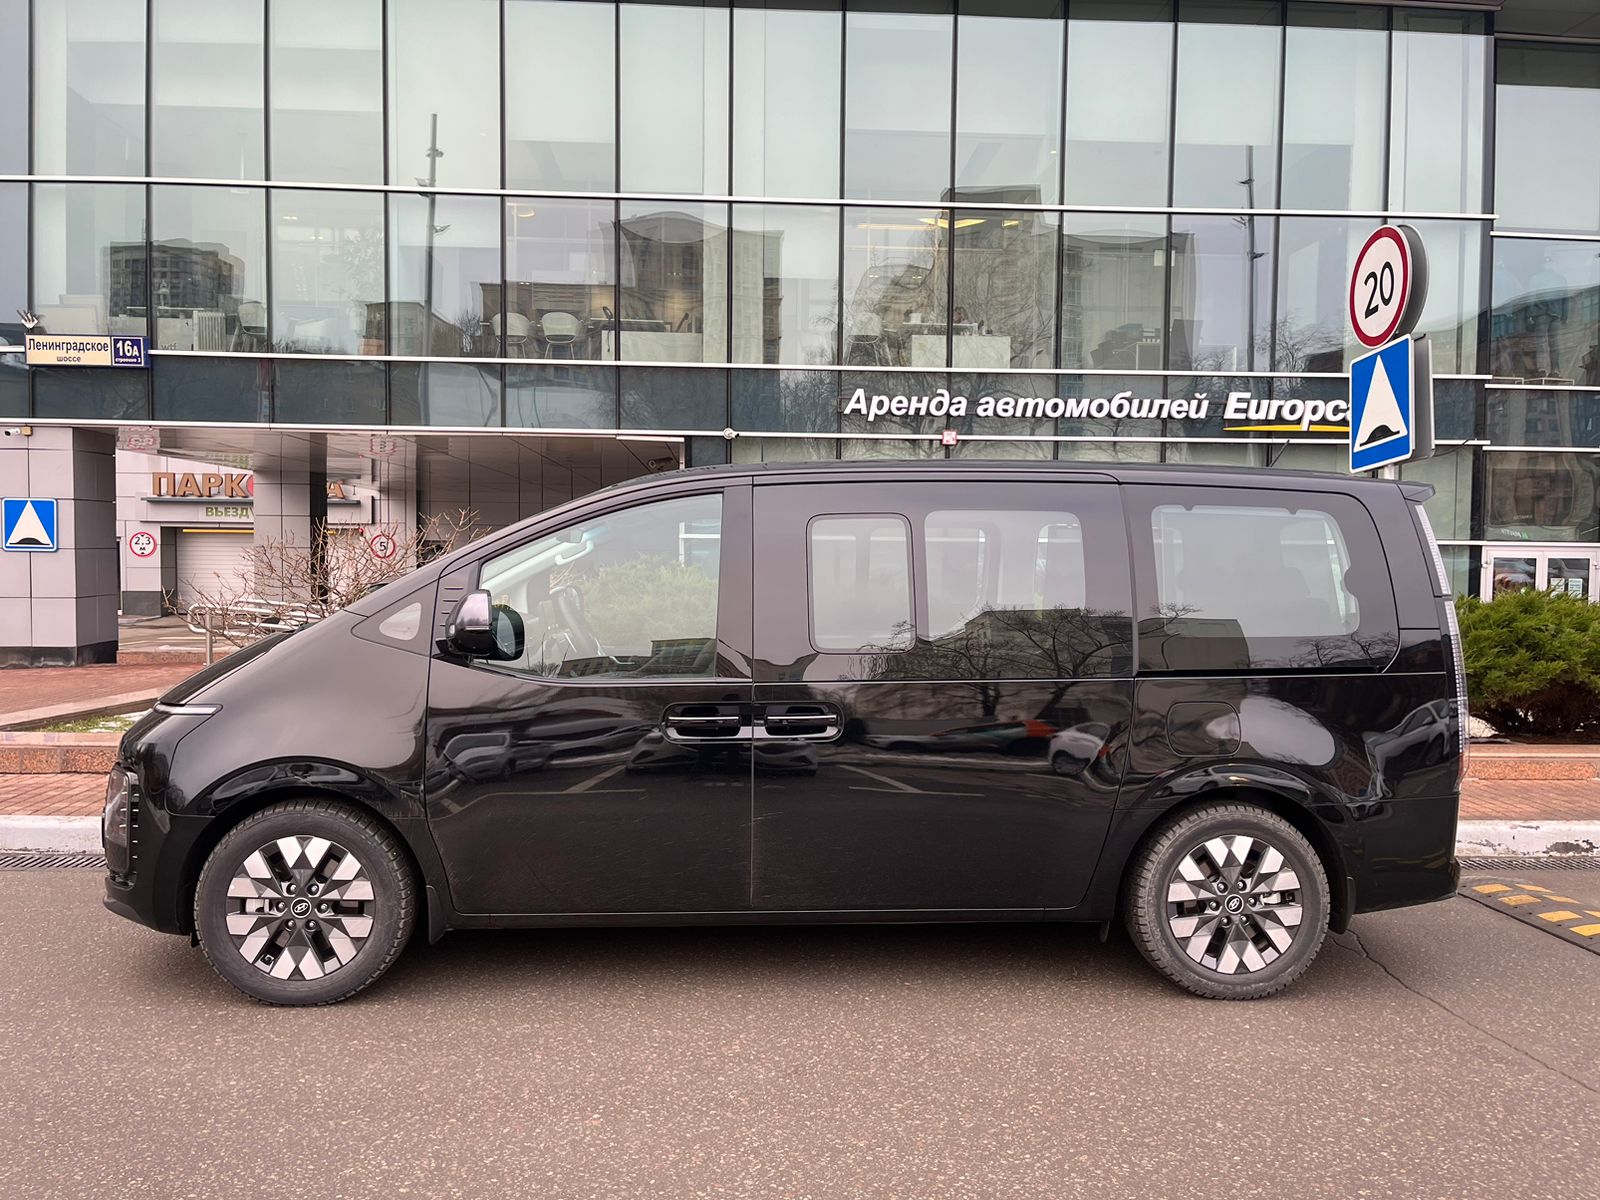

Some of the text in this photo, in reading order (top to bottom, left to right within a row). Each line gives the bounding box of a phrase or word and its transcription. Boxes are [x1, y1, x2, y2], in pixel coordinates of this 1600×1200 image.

[1364, 261, 1394, 319] 20
[28, 338, 109, 353] Ленинградское
[116, 340, 140, 357] 16А
[56, 355, 82, 363] шоссе
[844, 388, 1209, 421] Аренда автомобилей
[205, 506, 249, 518] ВЪЕЗД
[379, 541, 387, 552] 5
